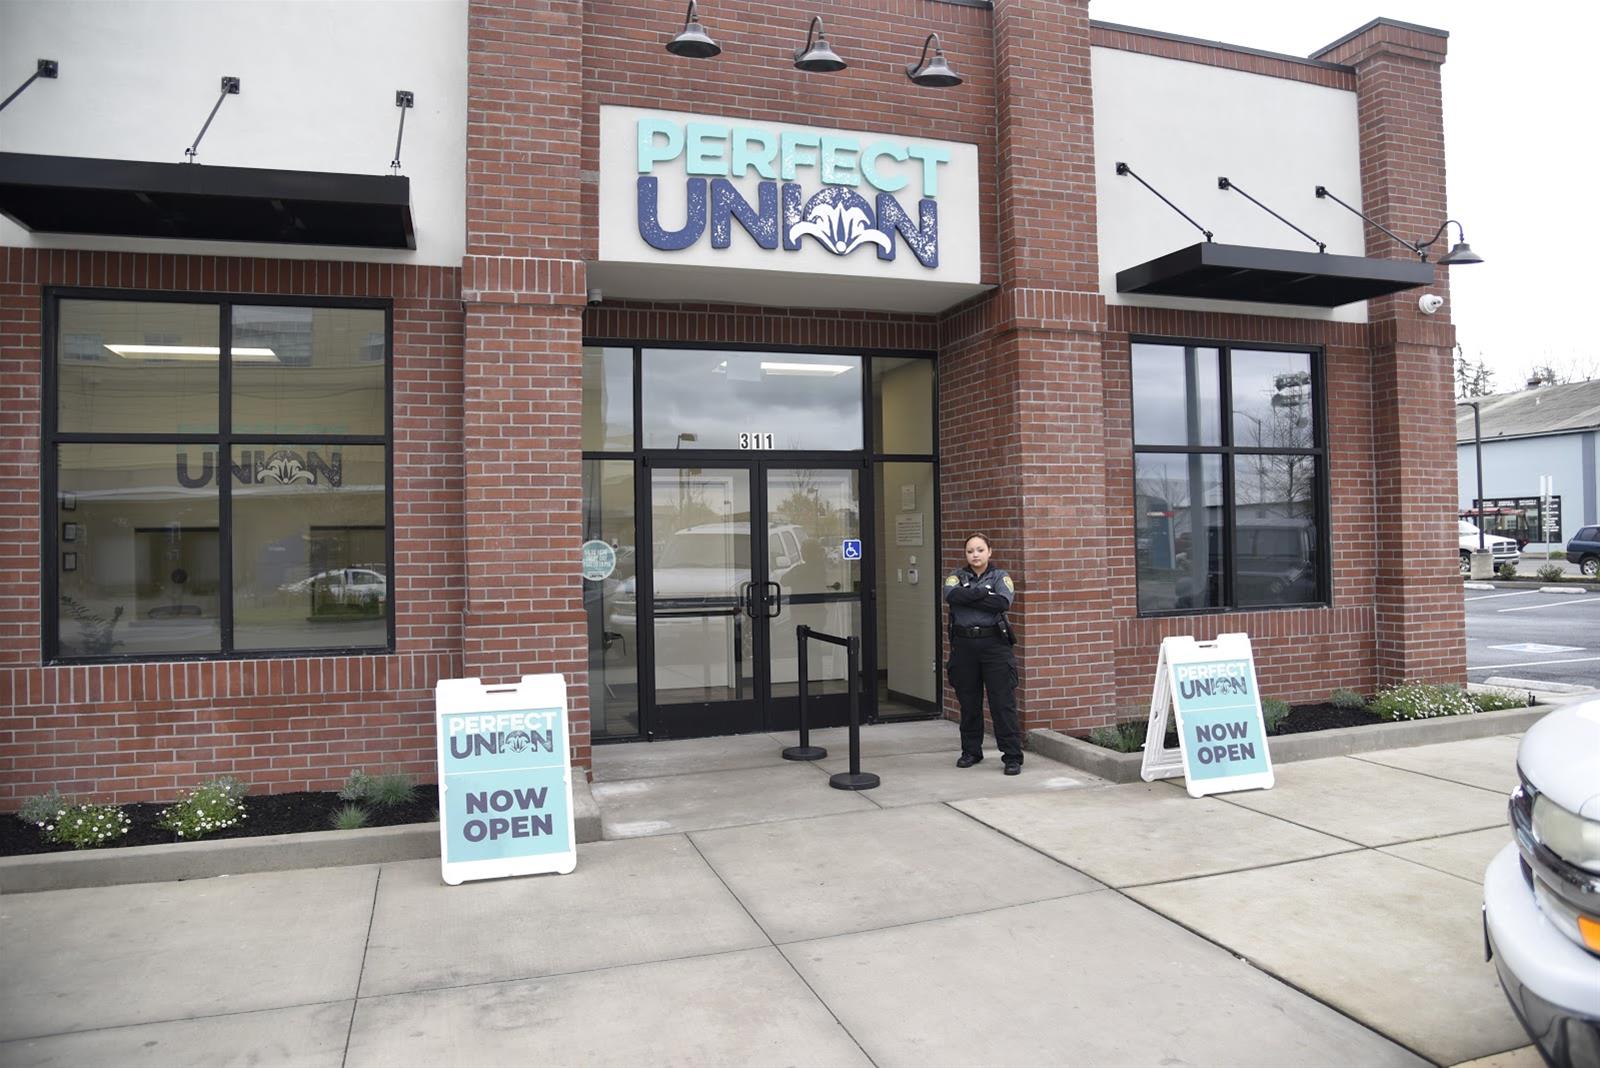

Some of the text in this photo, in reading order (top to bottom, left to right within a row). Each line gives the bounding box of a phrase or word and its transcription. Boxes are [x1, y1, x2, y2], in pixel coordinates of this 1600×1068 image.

[637, 118, 950, 198] PERFECT
[637, 176, 938, 269] UNION
[740, 433, 772, 449] 311
[176, 450, 342, 489] UNION
[1178, 663, 1247, 680] PERFECT
[1179, 677, 1248, 700] UNION
[449, 712, 557, 737] PERFECT
[1195, 721, 1248, 743] NOW
[450, 729, 554, 760] UNION
[1197, 742, 1256, 765] OPEN
[465, 786, 549, 815] NOW
[463, 813, 553, 843] OPEN
